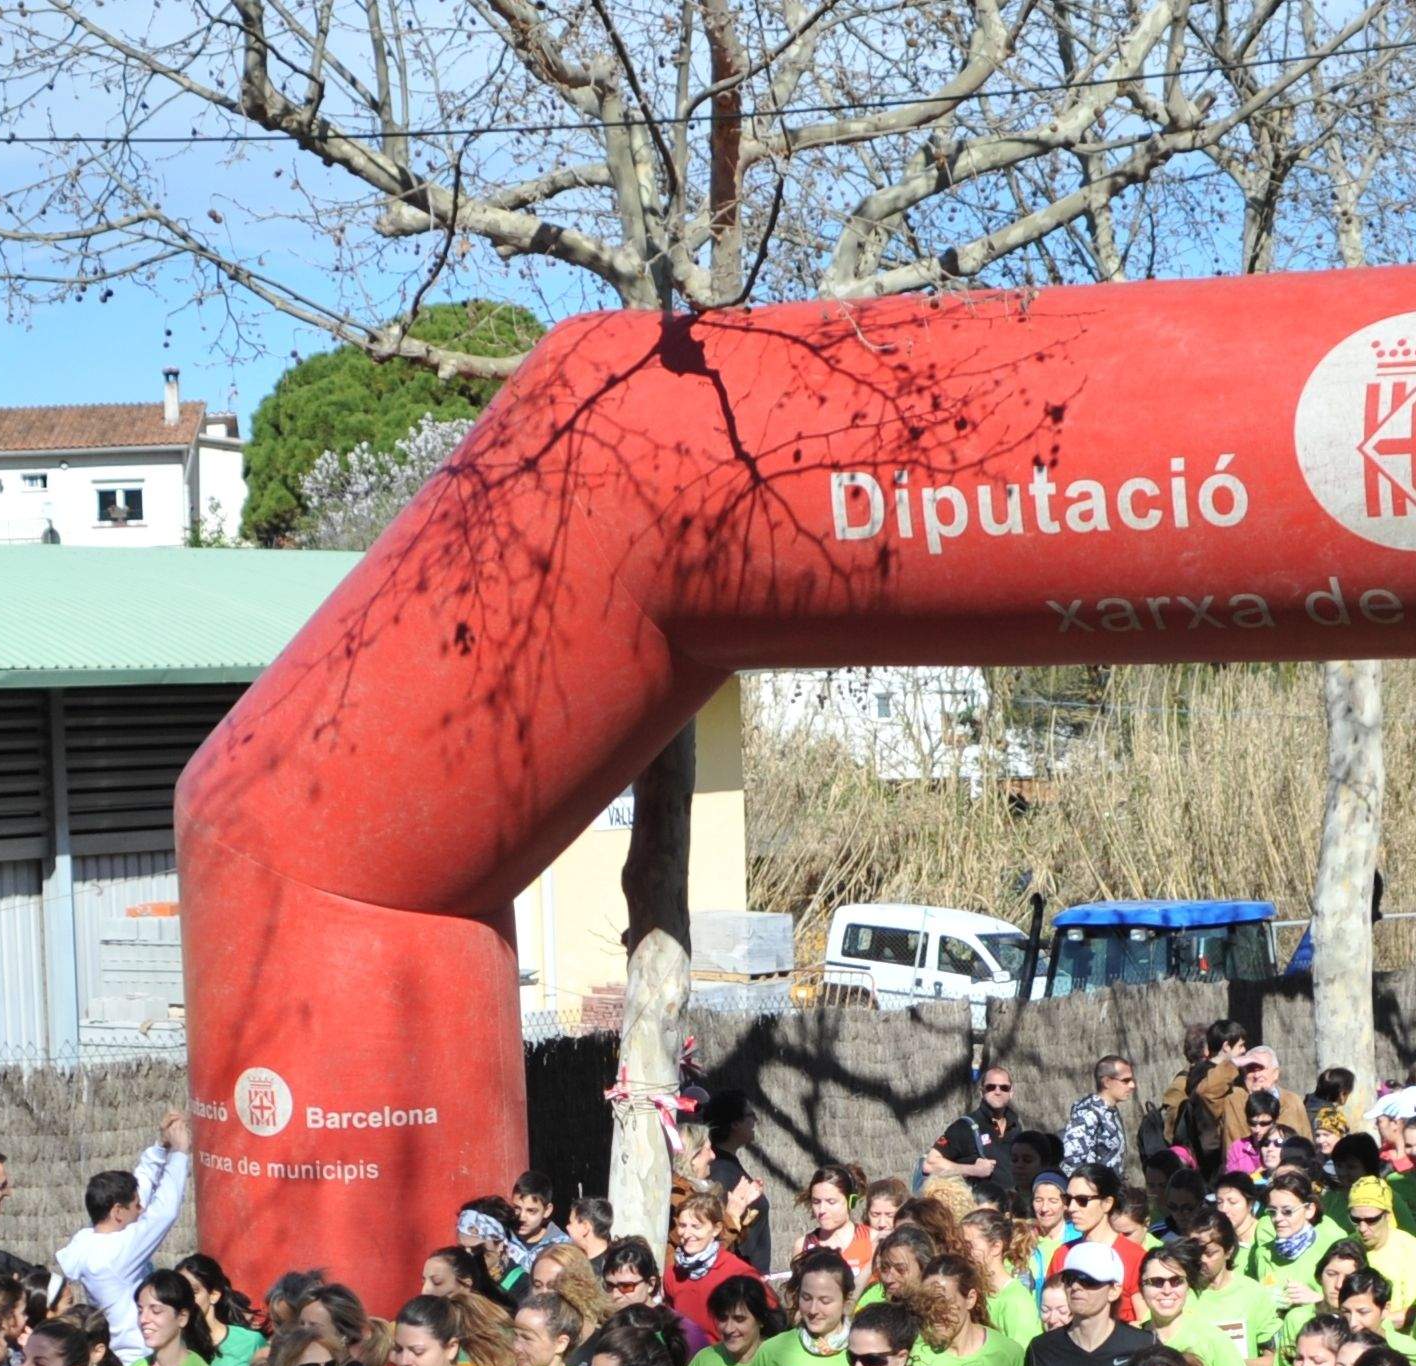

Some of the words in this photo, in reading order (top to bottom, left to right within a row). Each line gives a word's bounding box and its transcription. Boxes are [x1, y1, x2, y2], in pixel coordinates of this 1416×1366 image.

[830, 454, 1248, 555] Diputació
[1046, 592, 1274, 634] xarxa
[1304, 577, 1402, 625] de
[306, 1105, 438, 1129] Barcelona
[199, 1152, 233, 1174] xarxa
[237, 1156, 261, 1178] de
[267, 1159, 379, 1184] municipis
